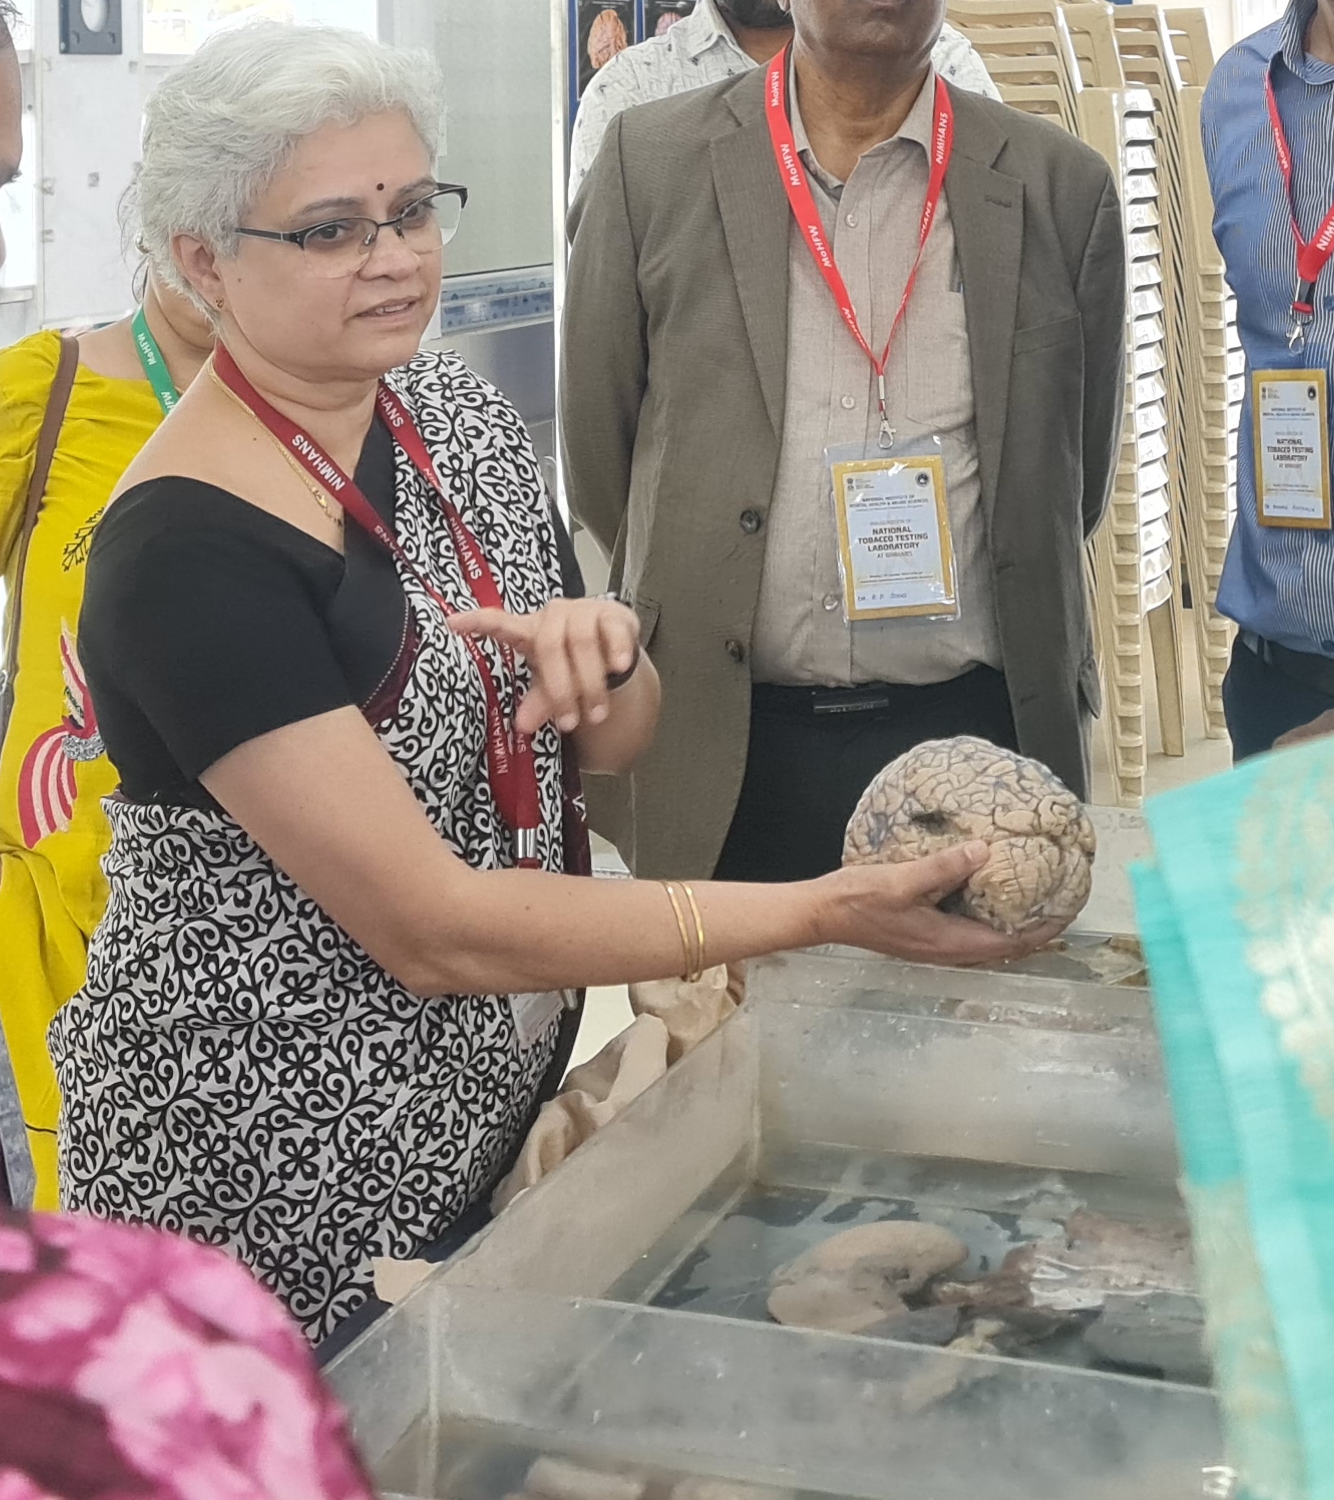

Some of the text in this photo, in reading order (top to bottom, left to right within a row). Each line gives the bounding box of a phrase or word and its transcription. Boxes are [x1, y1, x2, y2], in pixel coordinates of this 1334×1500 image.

[934, 111, 948, 165] NIMHANS
[780, 143, 802, 187] MoHFW
[807, 224, 832, 268] MoHFW
[378, 386, 405, 429] HANS
[292, 433, 346, 491] NIMHANS
[449, 516, 483, 581] NIMHANS
[858, 533, 928, 544] TOBACCO TESTING
[868, 542, 919, 552] LABORATORY
[872, 526, 912, 535] NATIONAL
[491, 706, 508, 775] NIMHANS
